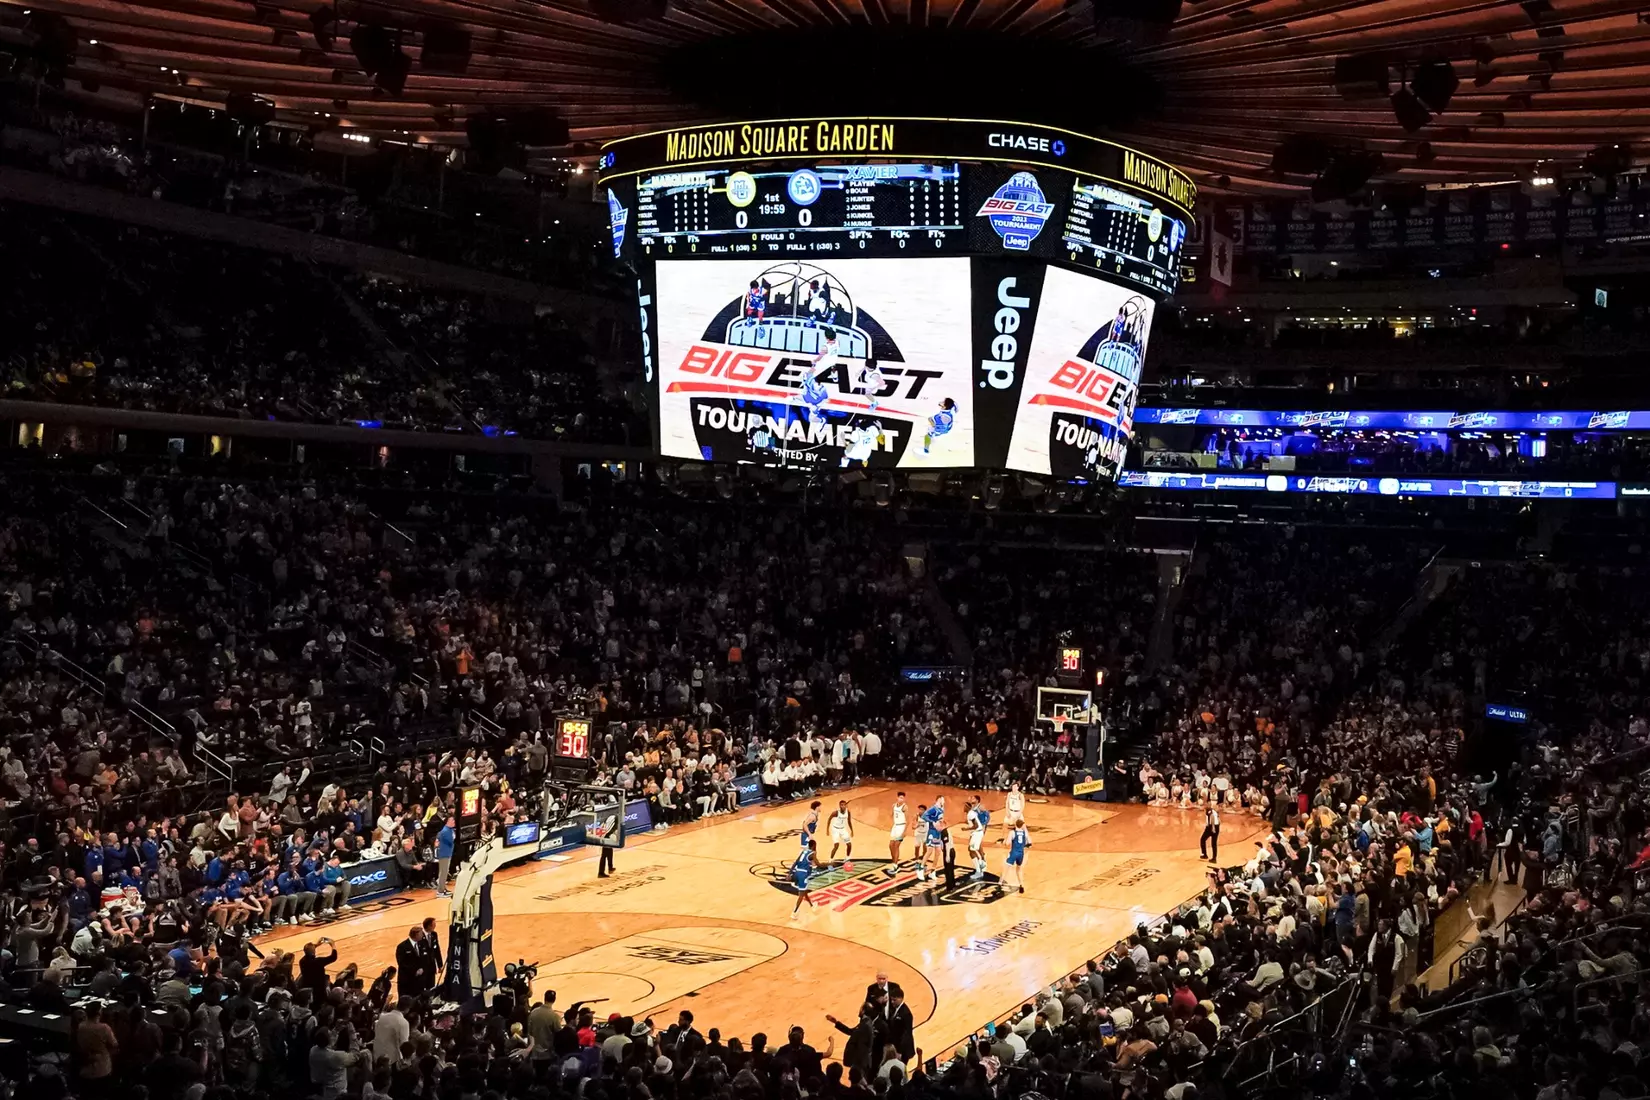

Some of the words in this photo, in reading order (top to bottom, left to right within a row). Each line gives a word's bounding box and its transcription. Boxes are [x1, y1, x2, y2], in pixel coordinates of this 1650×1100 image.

[666, 130, 735, 162] MADISON
[740, 124, 809, 156] SQUARE
[816, 121, 894, 152] GARDEN
[988, 133, 1050, 153] CHASE
[846, 165, 898, 180] XAVIER
[1124, 150, 1167, 193] MADISON
[764, 193, 780, 202] 1st
[758, 204, 786, 215] 19:59
[985, 199, 1017, 210] BIG
[1016, 203, 1052, 213] EAST
[735, 211, 748, 229] 0
[798, 208, 812, 227] 0
[994, 219, 1041, 230] TOURNAMENT
[1007, 236, 1028, 247] Jeep
[679, 345, 771, 383] BIG
[1048, 360, 1115, 402] BIG
[805, 453, 819, 464] BY
[1297, 479, 1306, 489] 0
[1063, 657, 1078, 669] 30
[563, 722, 588, 736] 19:59
[563, 737, 584, 757] 30
[959, 918, 1044, 956] Schweppes
[452, 945, 462, 985] NBA
